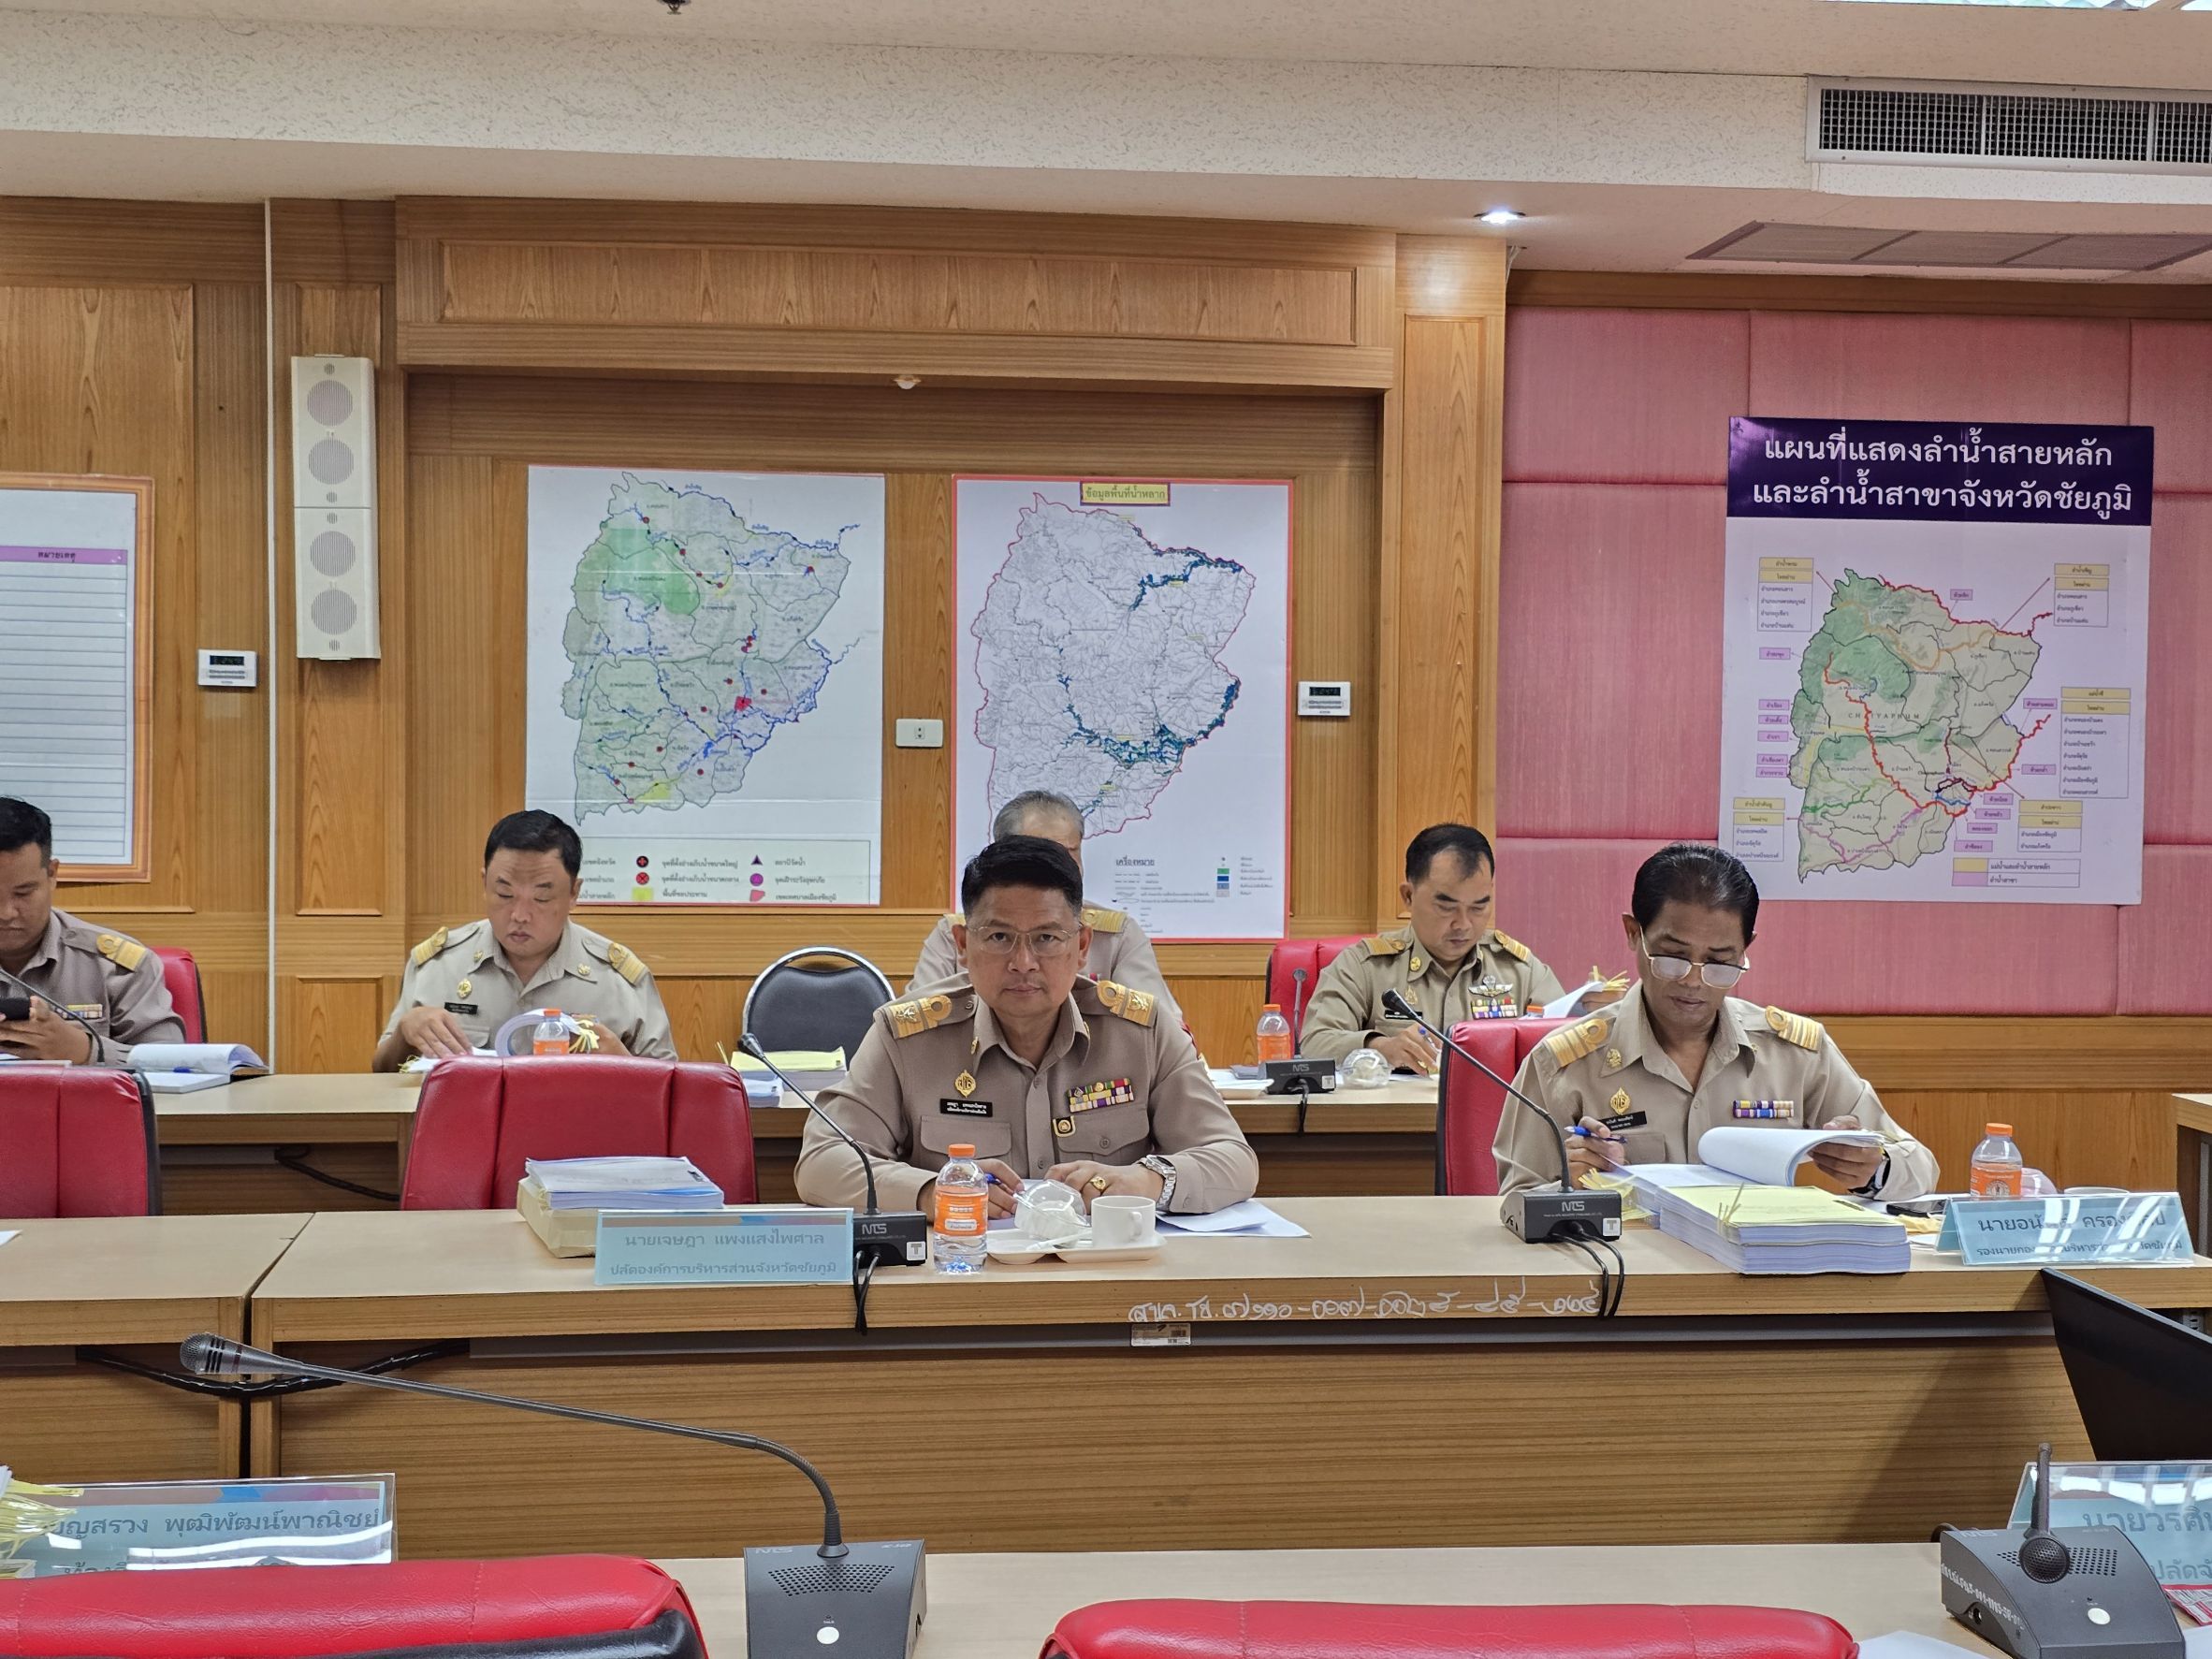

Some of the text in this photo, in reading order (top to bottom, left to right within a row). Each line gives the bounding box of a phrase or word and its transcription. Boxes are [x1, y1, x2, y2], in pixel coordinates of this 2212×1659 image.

[1765, 427, 2112, 466] แผนที่แสดงลำน้ำสายหลัก
[1085, 485, 1166, 501] ข้อมูลพื้นที่น้ำหลาก
[1754, 469, 2132, 519] และลำน้ำสาขาจังหวัดชัยภูมิ
[625, 1228, 824, 1249] นายเจษฎา แพงแสงไพศาล
[610, 1261, 837, 1277] ปลัดองค์การบริหารส่วนจังหวัดชัยภูมิ
